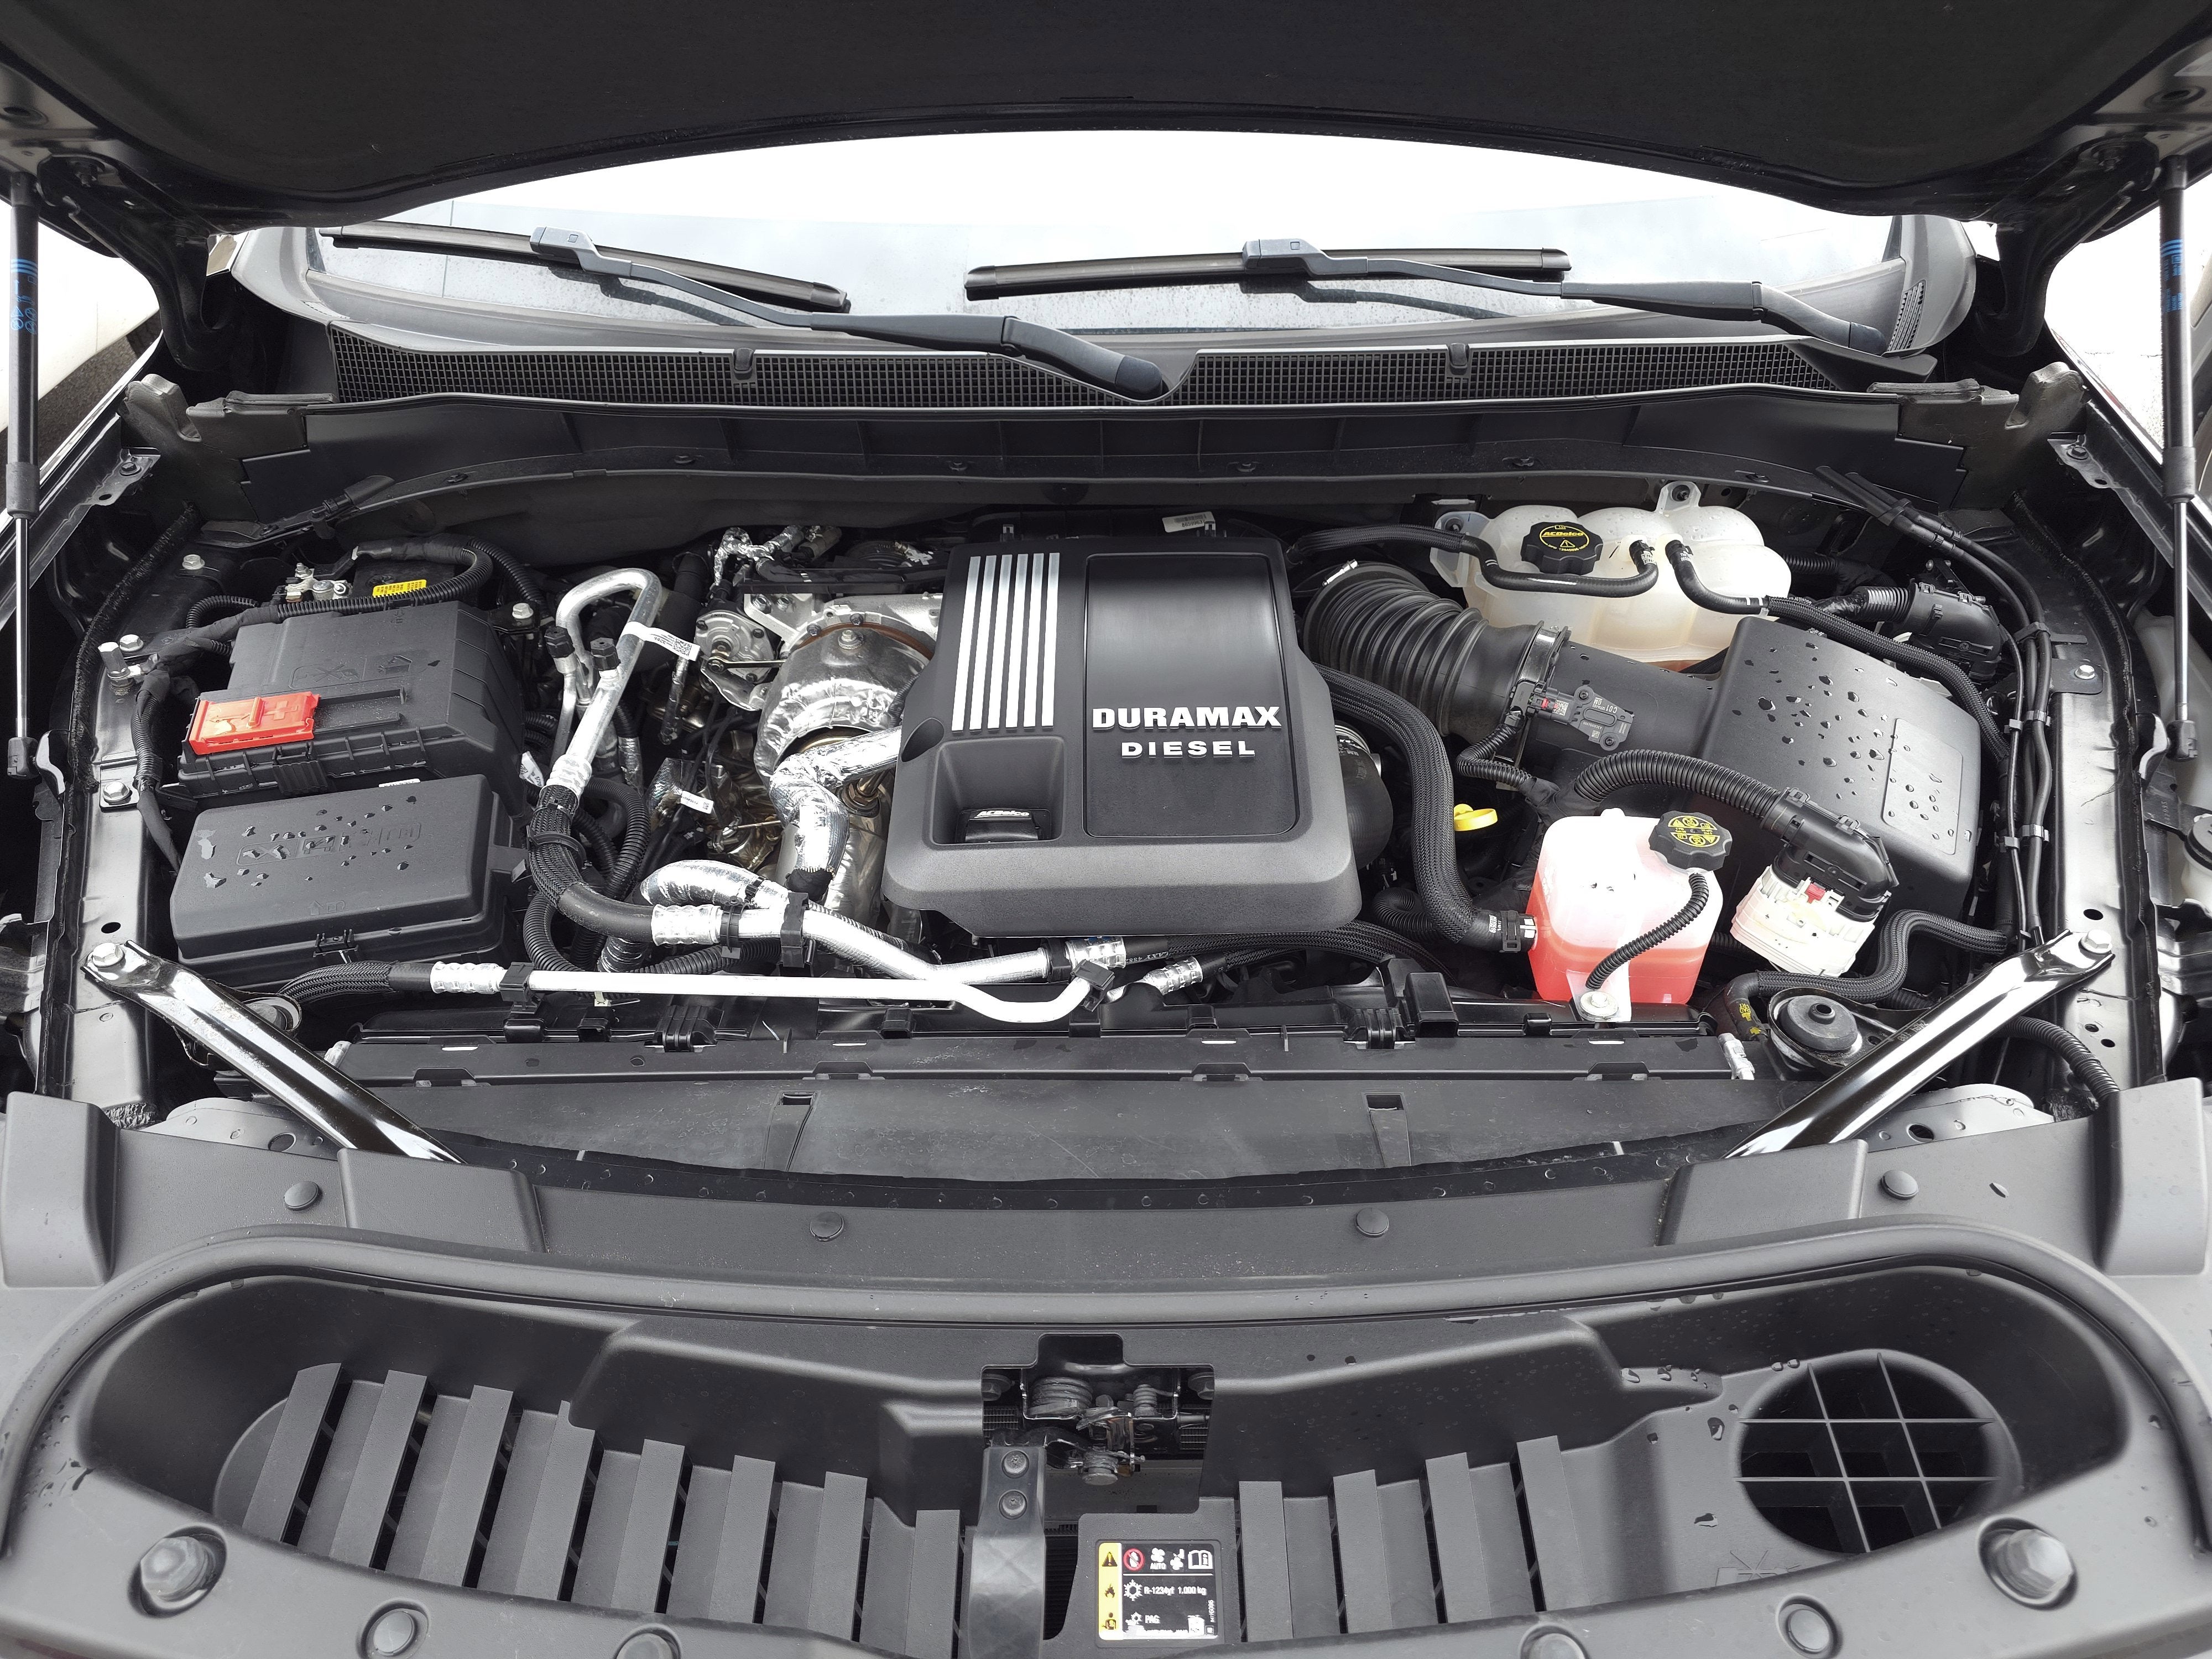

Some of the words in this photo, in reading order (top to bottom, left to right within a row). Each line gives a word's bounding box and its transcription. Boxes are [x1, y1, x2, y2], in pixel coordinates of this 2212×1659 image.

[1092, 706, 1281, 730] DURAMAX
[1121, 740, 1255, 758] DIESEL
[1144, 1586, 1175, 1596] R-1234yf
[1177, 1586, 1196, 1594] 1.000
[1197, 1585, 1207, 1596] kg
[1145, 1614, 1161, 1624] PAG
